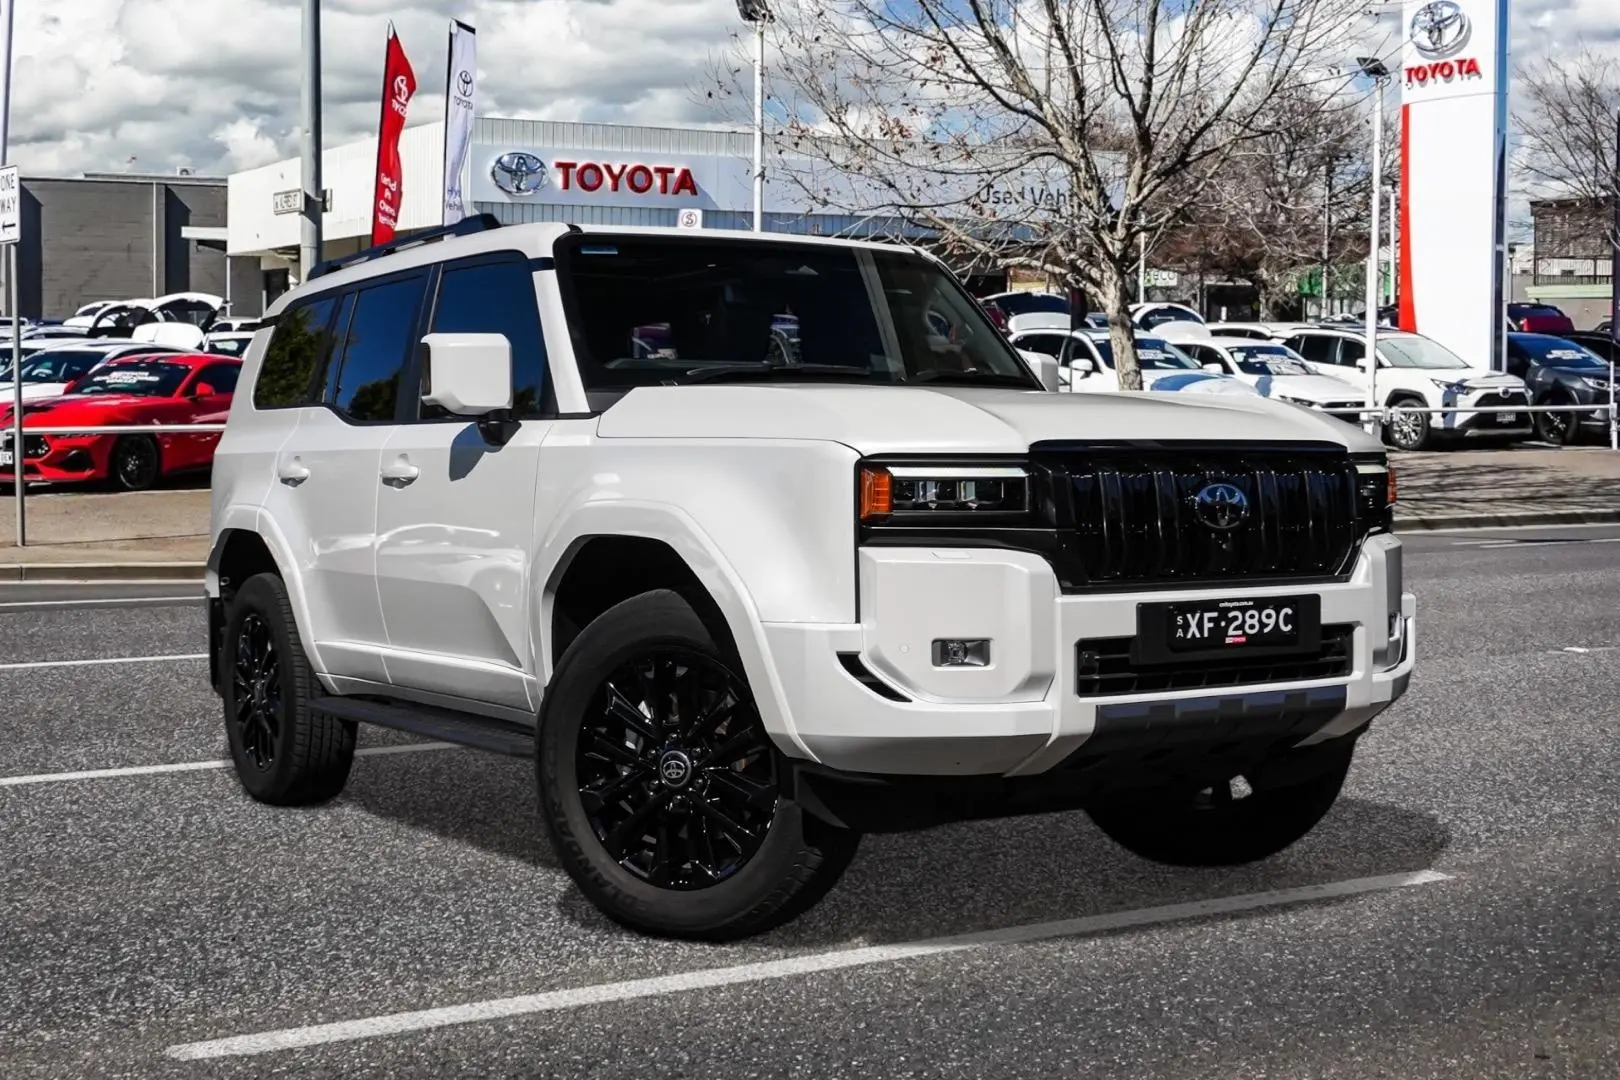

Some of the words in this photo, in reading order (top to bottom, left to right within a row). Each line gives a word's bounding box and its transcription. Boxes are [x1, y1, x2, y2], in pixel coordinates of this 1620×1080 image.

[1404, 58, 1481, 83] TOYOTA
[0, 173, 15, 192] ONE
[554, 161, 698, 196] TOYOTA
[0, 196, 17, 213] WAY
[978, 183, 1025, 205] Used
